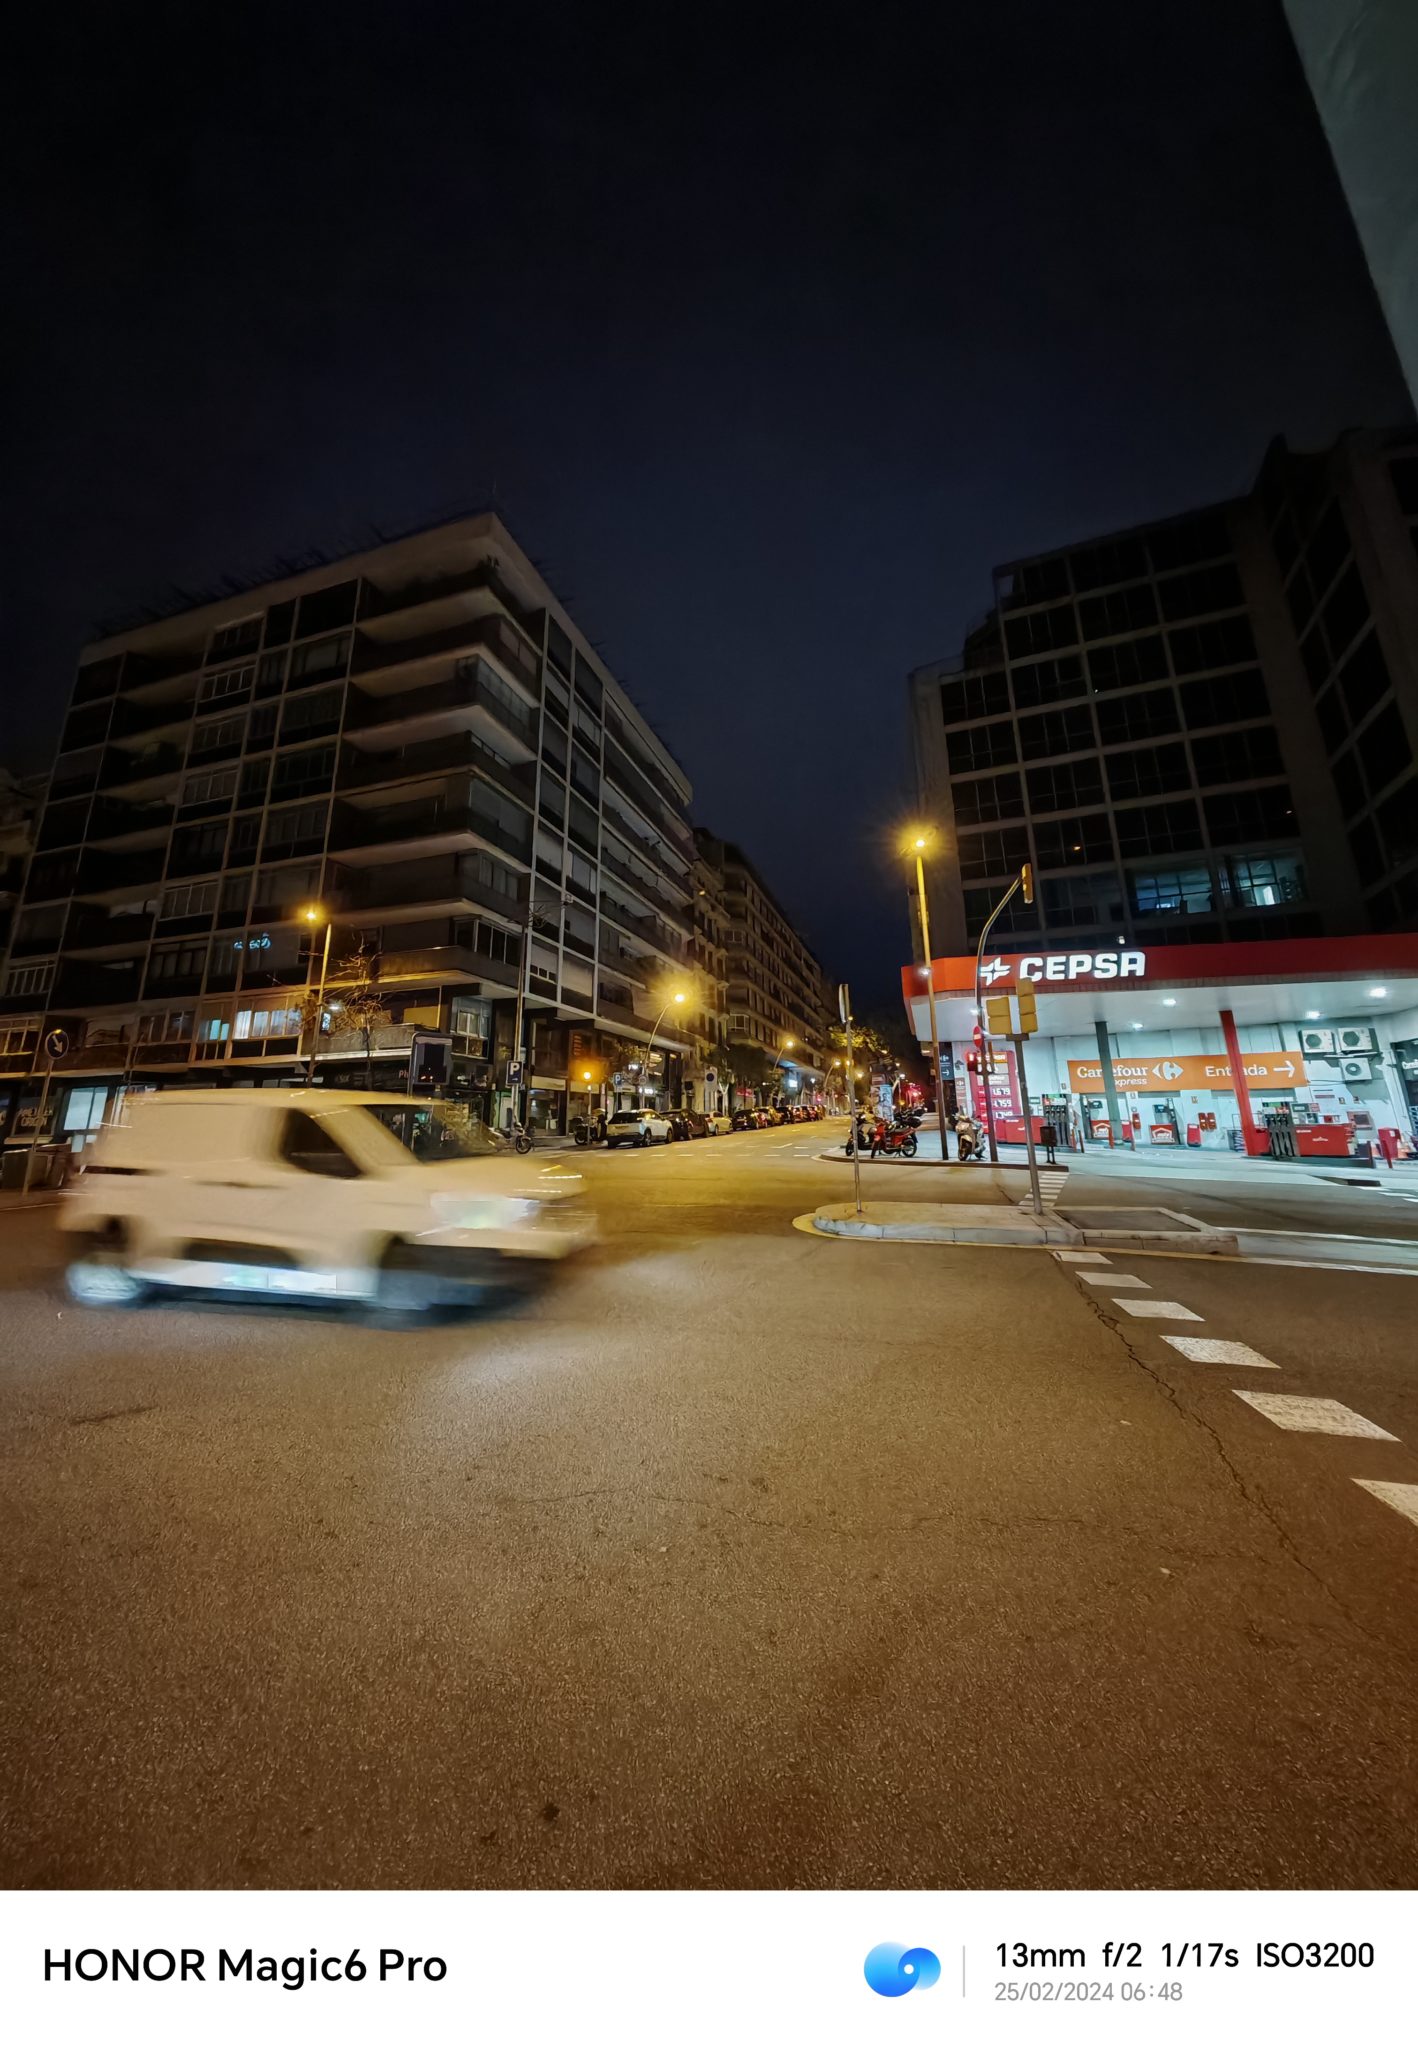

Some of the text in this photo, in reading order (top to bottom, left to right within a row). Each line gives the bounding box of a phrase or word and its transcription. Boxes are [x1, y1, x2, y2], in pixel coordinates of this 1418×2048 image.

[1020, 952, 1146, 983] CEPSA
[510, 1062, 520, 1075] P
[1077, 1065, 1148, 1078] Carefour
[1205, 1064, 1269, 1077] Entada
[615, 1074, 622, 1085] P
[1114, 1078, 1148, 1087] xpress
